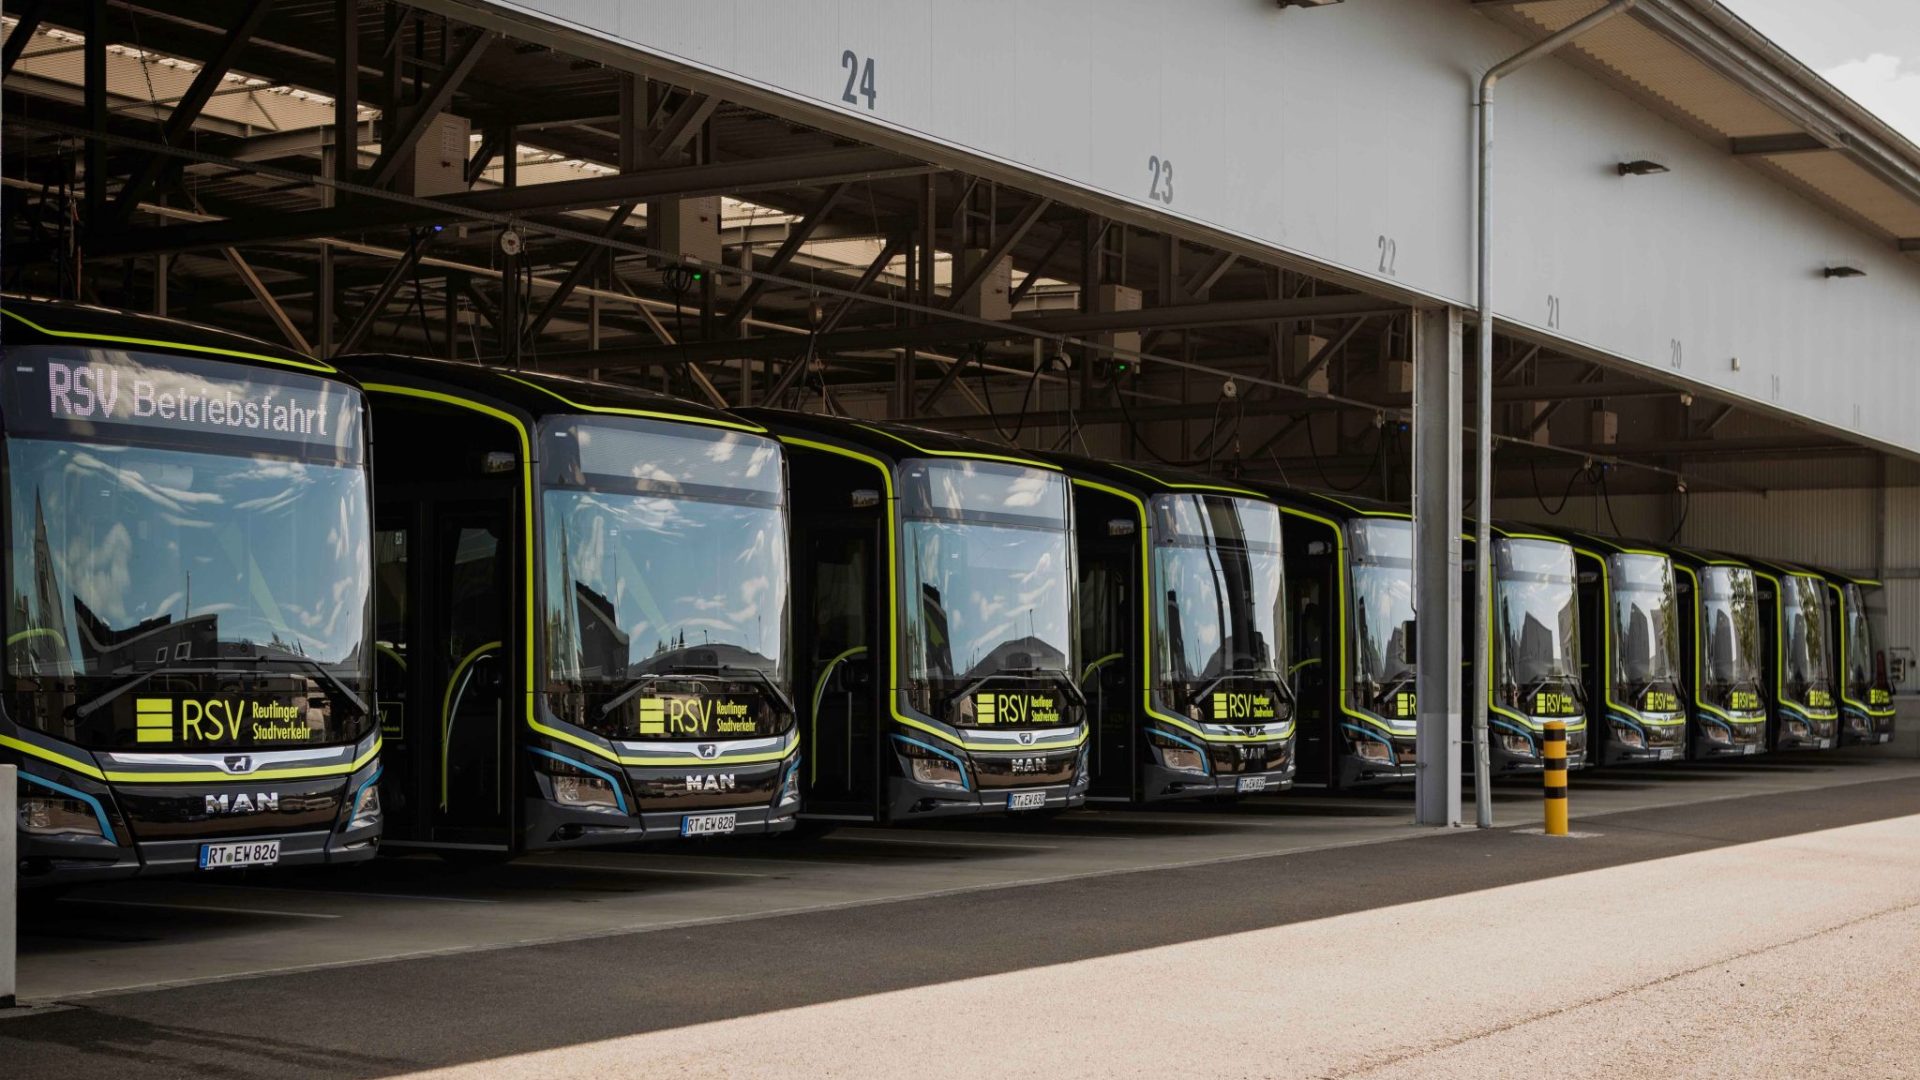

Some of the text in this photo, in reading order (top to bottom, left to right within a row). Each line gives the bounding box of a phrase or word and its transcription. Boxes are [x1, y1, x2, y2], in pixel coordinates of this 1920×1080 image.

[842, 50, 876, 110] 24
[1149, 155, 1173, 204] 23
[1378, 235, 1395, 276] 22
[1547, 294, 1559, 330] 21
[1671, 338, 1681, 369] 20
[49, 363, 327, 436] RSV Betriebsfahrt
[252, 702, 298, 720] Reutlinger
[716, 699, 748, 717] Reutlinger
[998, 694, 1028, 722] RSV
[1230, 693, 1251, 718] RSV
[1546, 694, 1560, 713] RSV
[1655, 692, 1667, 710] RSV
[183, 700, 244, 741] RSV
[670, 700, 712, 732] RSV
[717, 717, 756, 732] Stadtverkehr
[253, 724, 311, 740] Stadtverkehr
[1011, 758, 1047, 772] MAN
[686, 774, 735, 791] MAN
[205, 792, 279, 814] MAN
[253, 844, 277, 861] 826
